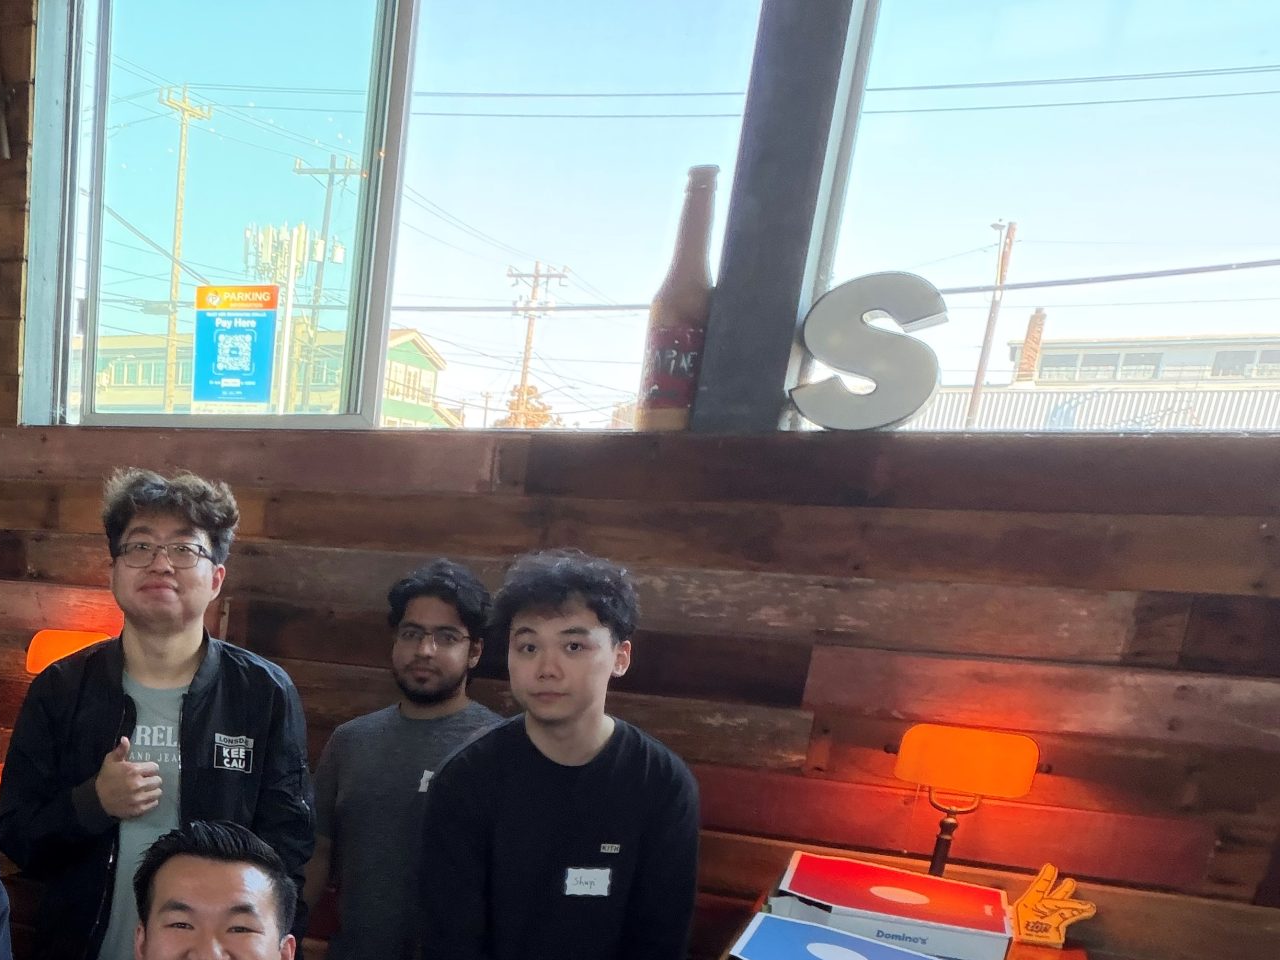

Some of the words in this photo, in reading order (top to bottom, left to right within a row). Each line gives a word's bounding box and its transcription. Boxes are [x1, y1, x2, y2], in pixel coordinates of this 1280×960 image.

[223, 291, 271, 302] PARKING
[215, 318, 232, 329] Pay
[234, 317, 257, 328] Here
[788, 270, 949, 431] S
[875, 929, 928, 945] Domino's
